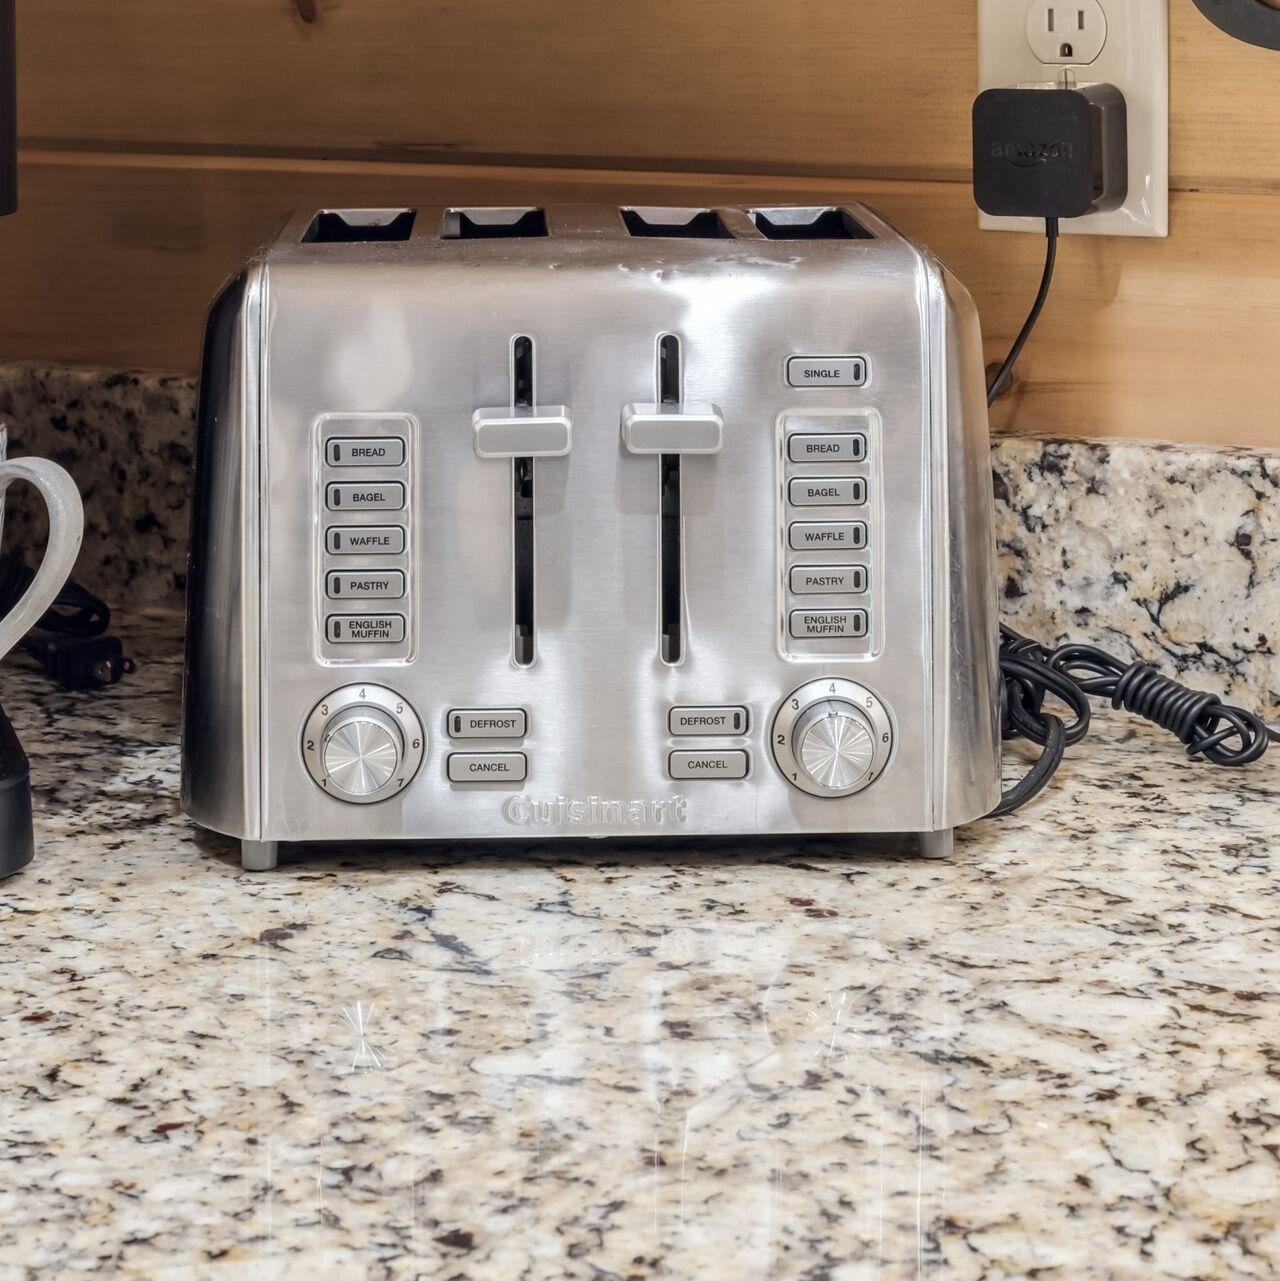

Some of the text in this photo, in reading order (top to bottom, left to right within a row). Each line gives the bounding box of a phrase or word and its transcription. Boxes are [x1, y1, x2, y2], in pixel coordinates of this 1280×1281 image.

[804, 369, 840, 378] SINGLE
[351, 448, 386, 457] BREAD
[806, 444, 840, 453] BREAD
[807, 488, 840, 497] BAGEL
[352, 493, 386, 502] BAGEL
[805, 532, 845, 541] WAFFLE
[349, 537, 390, 546] WAFFLE
[350, 581, 389, 591] PASTRY
[806, 577, 844, 586] PASTRY
[804, 616, 847, 624] ENGLISH
[349, 621, 392, 629] ENGLISH
[806, 625, 844, 633] MUFFIN
[351, 630, 389, 638] MUFFIN
[829, 683, 836, 693] 4
[359, 688, 366, 699] 4
[791, 698, 799, 710] 3
[866, 697, 873, 708] 5
[321, 704, 329, 715] 3
[396, 702, 403, 714] 5
[470, 719, 516, 729] DEFROST
[680, 717, 726, 726] DEFROST
[777, 734, 785, 745] 2
[882, 732, 889, 743] 6
[307, 740, 314, 751] 2
[412, 738, 420, 749] 6
[469, 763, 510, 772] CANCEL
[688, 760, 728, 770] CANCEL
[792, 772, 797, 781] 1
[322, 778, 327, 787] 1
[397, 778, 404, 787] 7
[501, 794, 689, 825] Cuisinart
